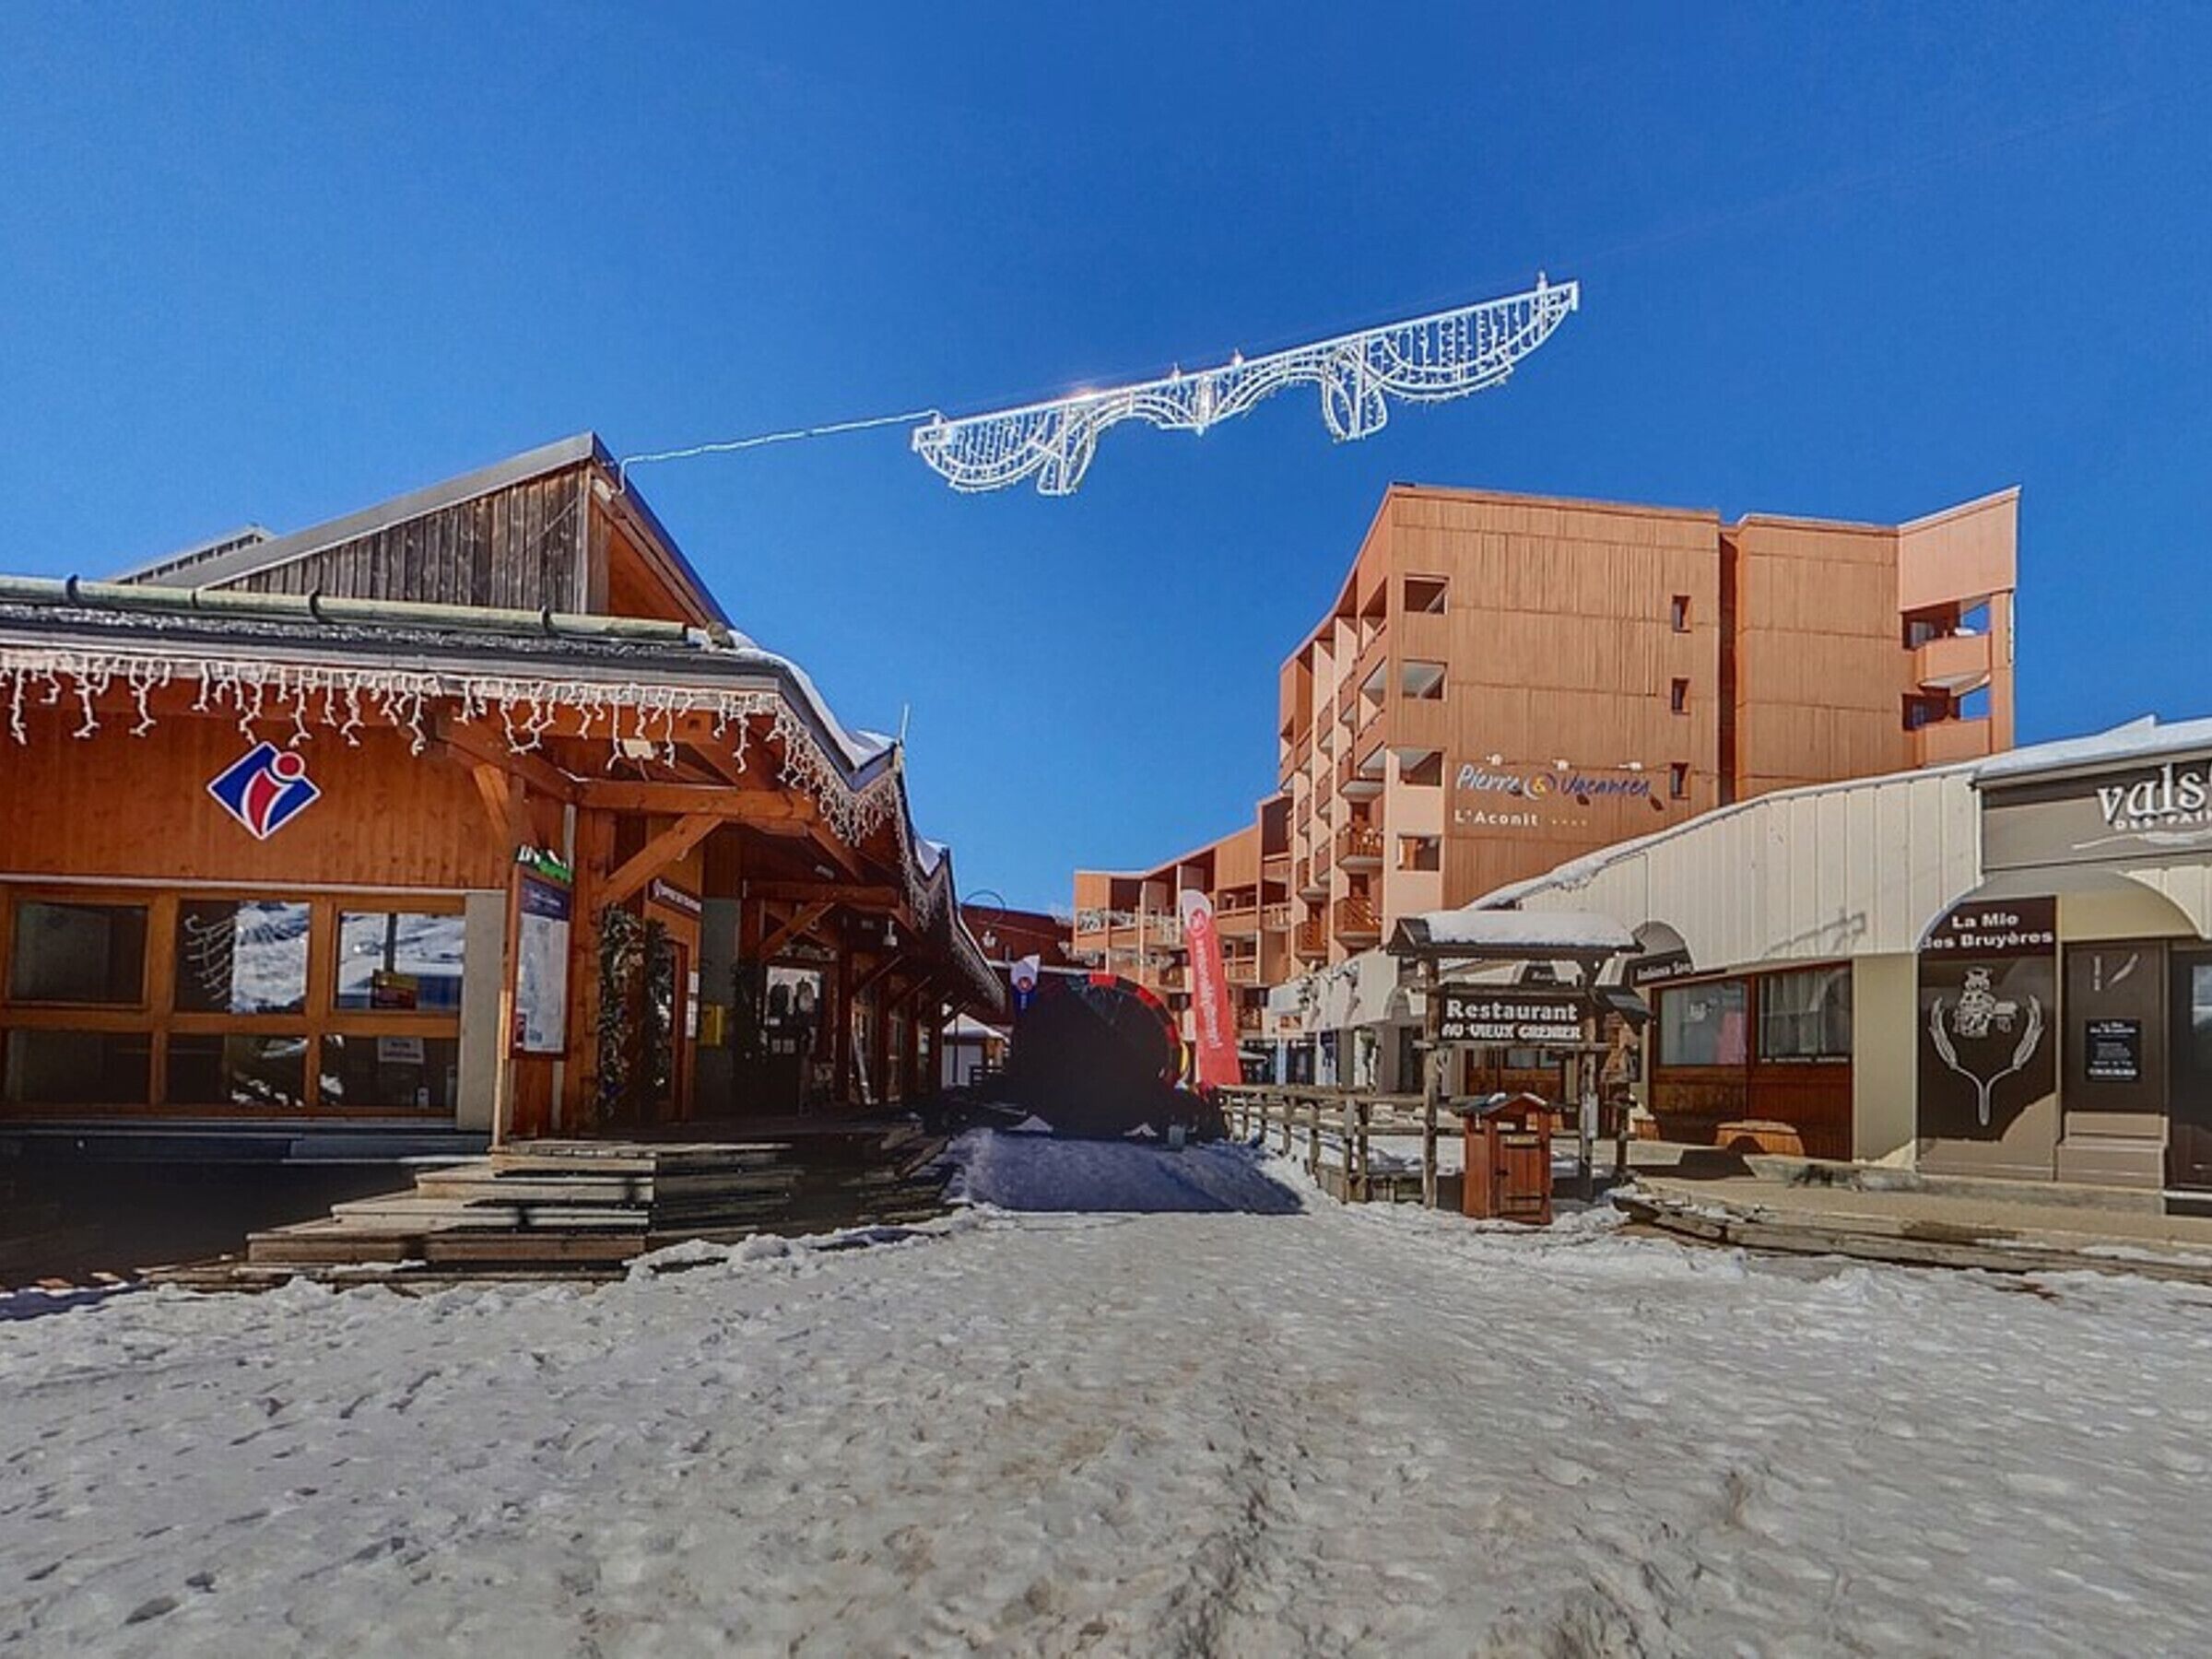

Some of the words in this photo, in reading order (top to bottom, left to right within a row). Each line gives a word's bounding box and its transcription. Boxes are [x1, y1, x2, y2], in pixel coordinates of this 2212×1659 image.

[1456, 763, 1520, 791] Pierre
[1560, 772, 1652, 796] Vacances
[2097, 762, 2212, 825] vals
[1454, 809, 1538, 826] L'Aconit
[1951, 915, 1976, 929] La
[1960, 930, 2053, 948] Bruyères
[1446, 998, 1577, 1020] Restaurant
[1441, 1024, 1464, 1038] AU
[1466, 1024, 1514, 1039] VIEUX
[1518, 1026, 1581, 1040] GRENIER
